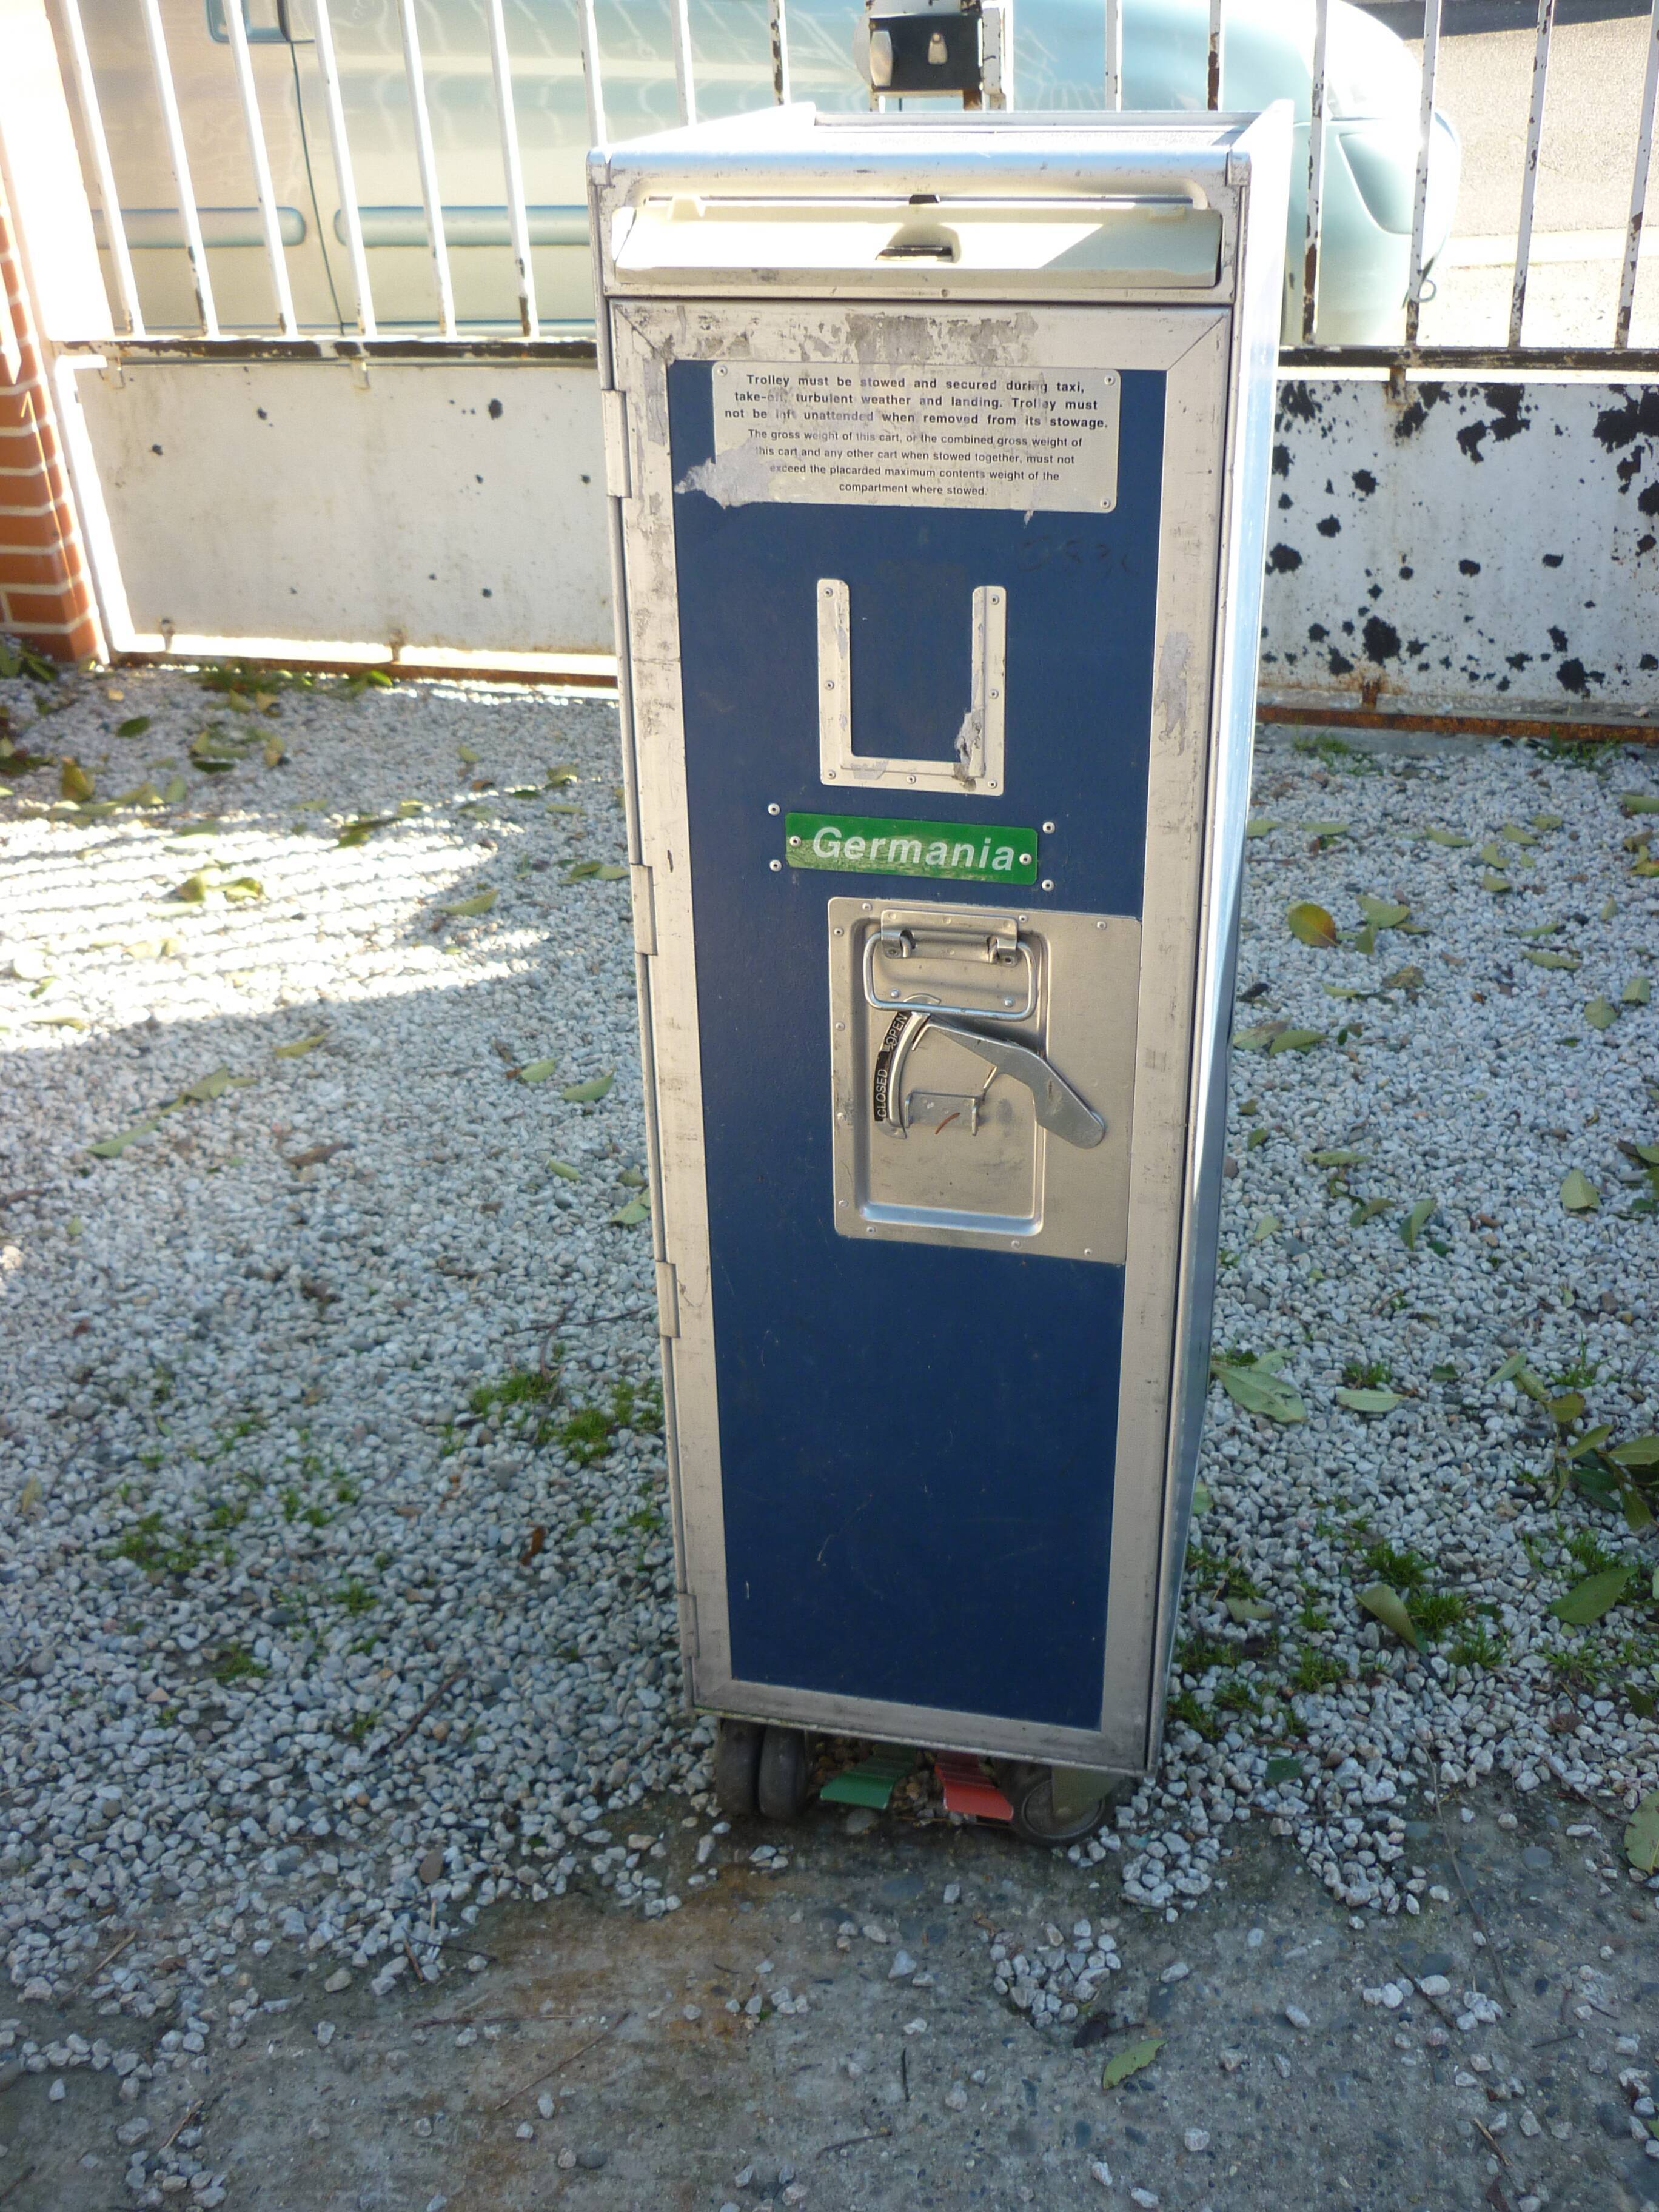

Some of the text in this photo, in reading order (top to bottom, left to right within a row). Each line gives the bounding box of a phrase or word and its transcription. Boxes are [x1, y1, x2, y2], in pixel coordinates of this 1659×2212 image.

[746, 374, 789, 387] Trolley
[799, 377, 828, 386] must
[837, 376, 852, 386] be
[860, 378, 905, 388] stowed
[914, 378, 937, 389] and
[946, 380, 996, 390] secured
[1057, 382, 1084, 394] taxi,
[796, 393, 853, 404] turbulent
[861, 395, 911, 405] weather
[919, 396, 942, 406] and
[951, 396, 1002, 410] landing.
[1011, 398, 1056, 411] Trolley
[1065, 400, 1098, 410] must
[725, 409, 745, 418] not
[753, 409, 768, 419] be
[804, 411, 874, 421] unattended
[882, 412, 914, 423] when
[923, 414, 978, 424] removed
[988, 414, 1016, 426] from
[1026, 415, 1041, 426] its
[1050, 417, 1108, 429] stowage.
[748, 429, 767, 438] The
[771, 431, 800, 441] gross
[804, 430, 838, 441] weight
[842, 431, 854, 441] of
[856, 432, 875, 441] this
[879, 433, 902, 443] cart,
[921, 434, 937, 443] the
[941, 434, 993, 444] combined
[997, 437, 1028, 447] gross
[1032, 436, 1067, 448] weight
[1071, 437, 1082, 447] of
[756, 446, 1074, 464] this cart and any other cart when stowed together, must not
[770, 464, 1059, 481] exceed the placarded maximum contents weight of the
[839, 483, 987, 496] compartment where stowed.
[813, 826, 1016, 871] Germania
[876, 1068, 888, 1118] CLOSED
